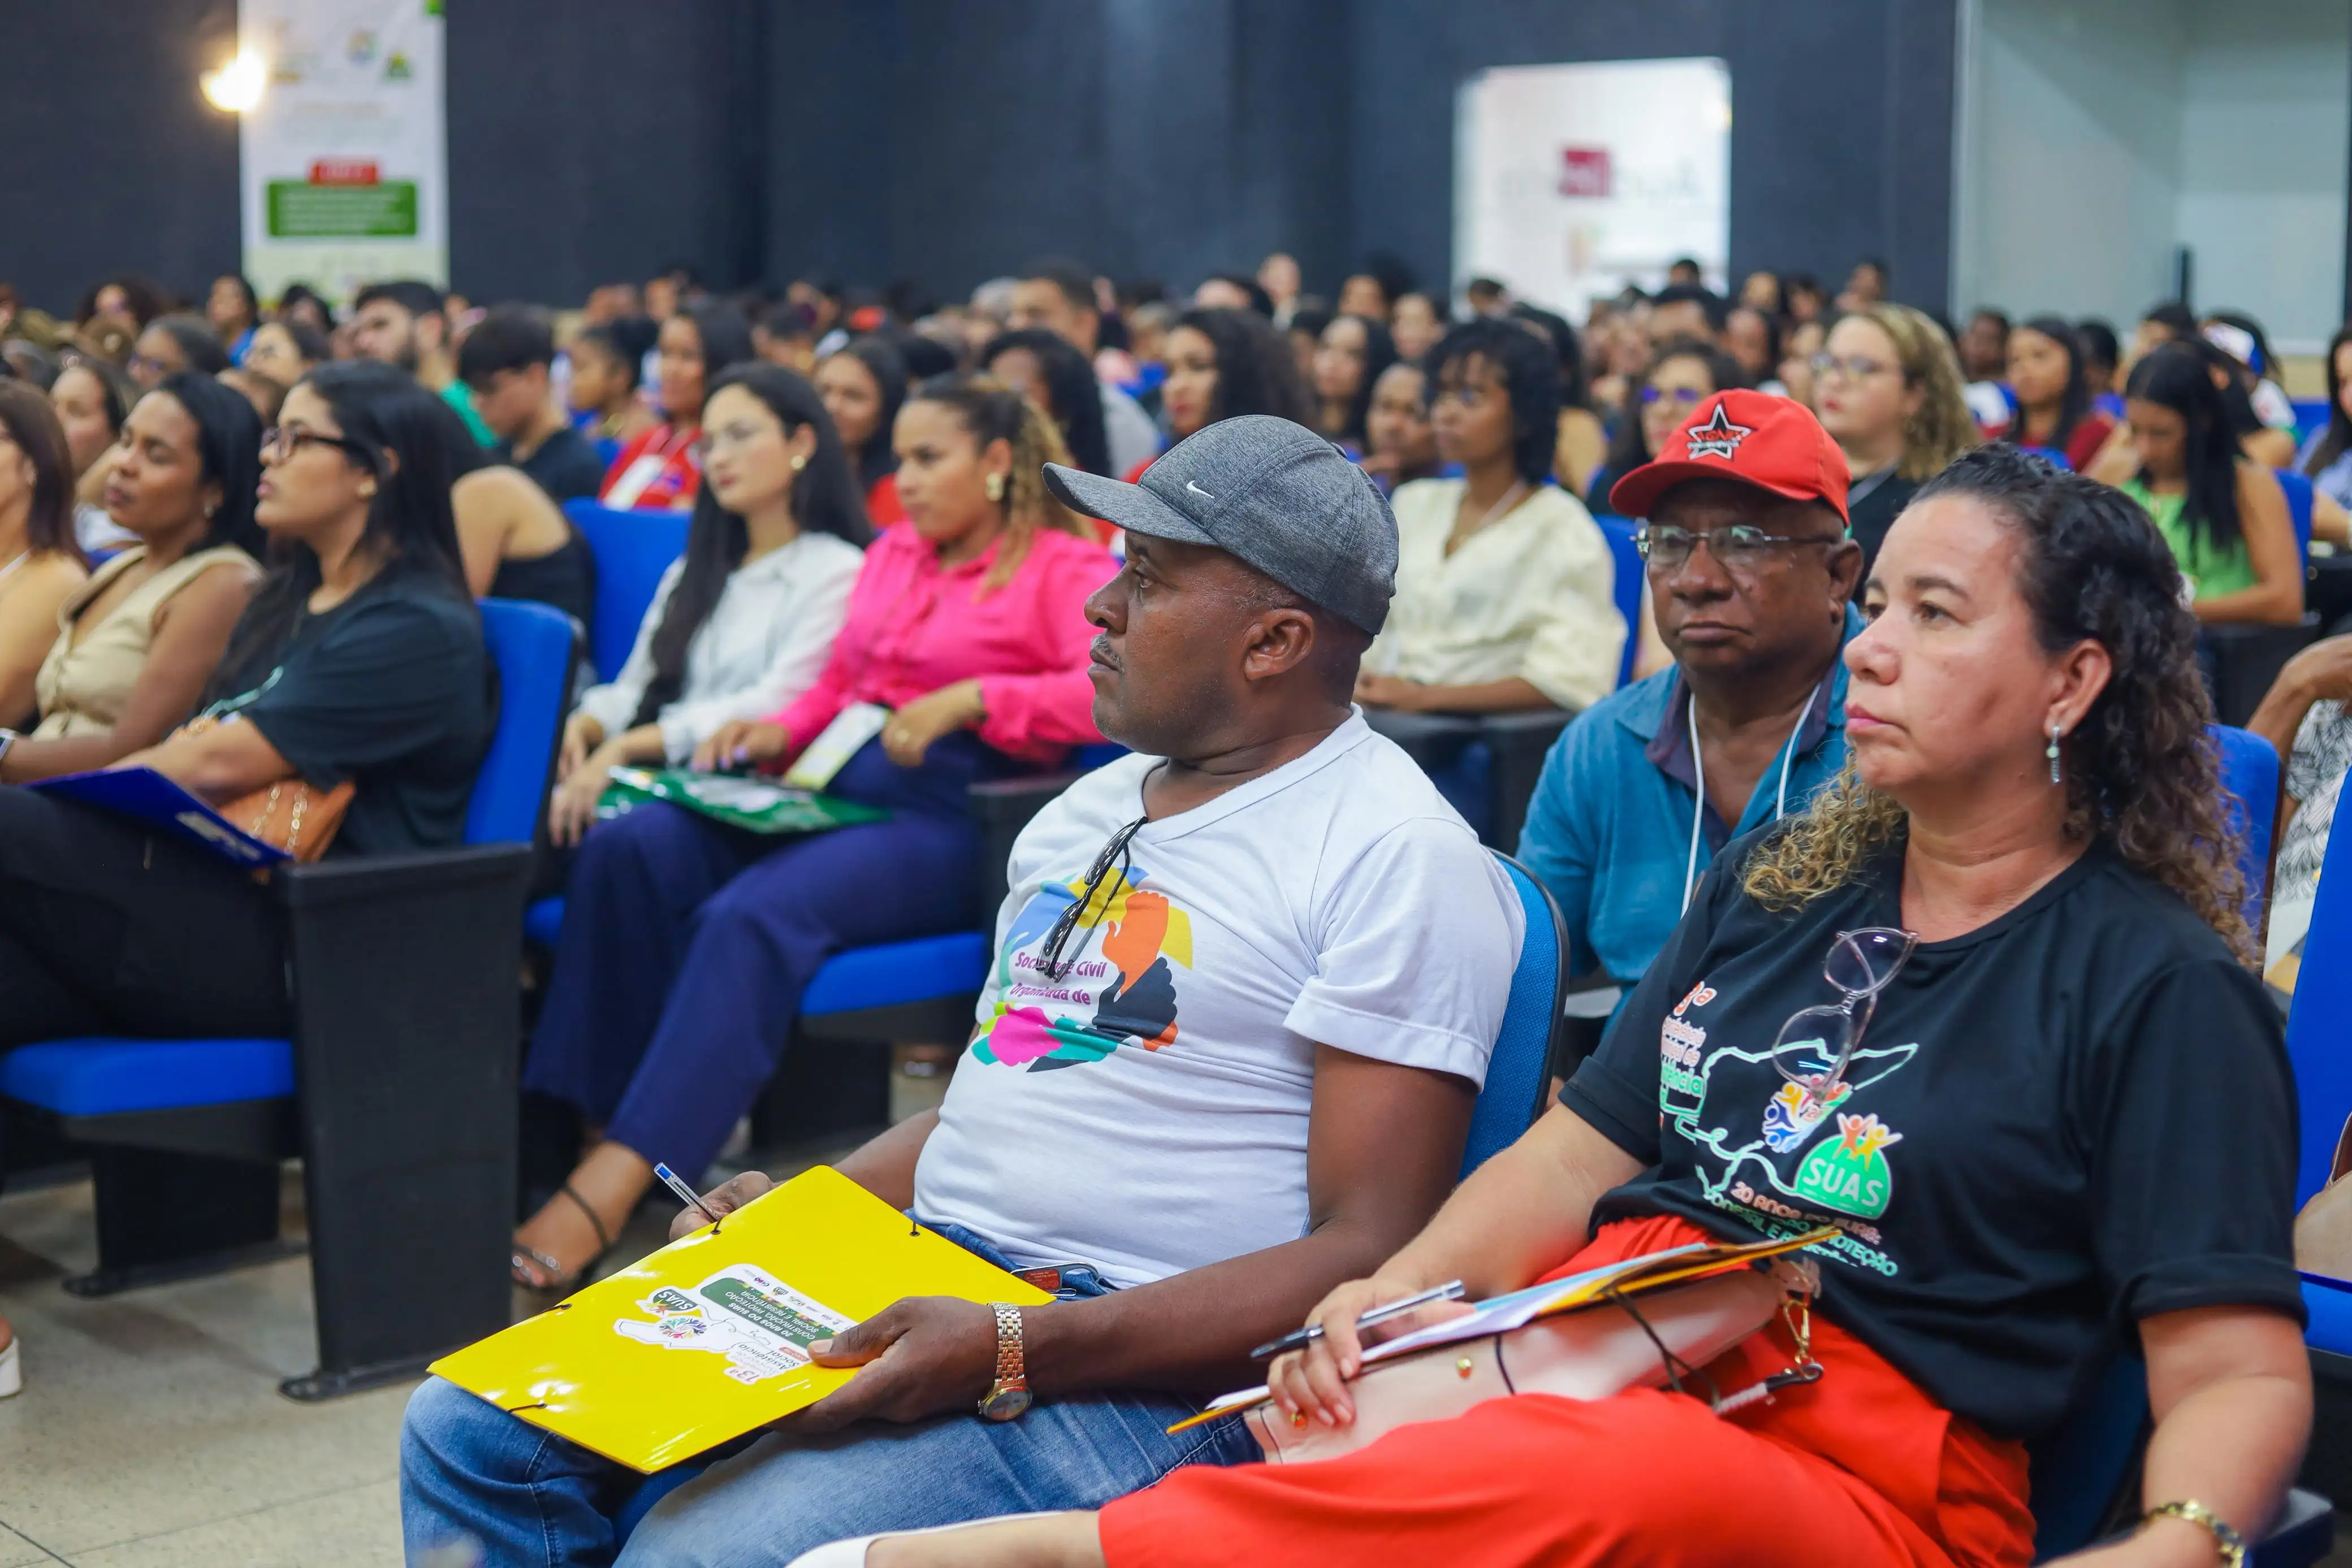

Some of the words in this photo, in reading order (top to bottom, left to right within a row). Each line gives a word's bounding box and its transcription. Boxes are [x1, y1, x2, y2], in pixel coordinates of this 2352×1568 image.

[1076, 961, 1108, 978] Civil
[1072, 989, 1091, 1005] de
[1802, 1158, 1884, 1207] SUAS
[1730, 1181, 1754, 1203] 20
[658, 1291, 693, 1310] SUAS
[725, 1291, 766, 1315] PROTEÇÃO
[728, 1302, 750, 1316] SUAS
[740, 1290, 786, 1317] RESISTÊNCIA
[748, 1313, 762, 1322] DO
[760, 1318, 781, 1333] ANOS
[790, 1318, 819, 1333] SOCIAL
[738, 1344, 792, 1370] Assistência
[766, 1350, 799, 1367] Social
